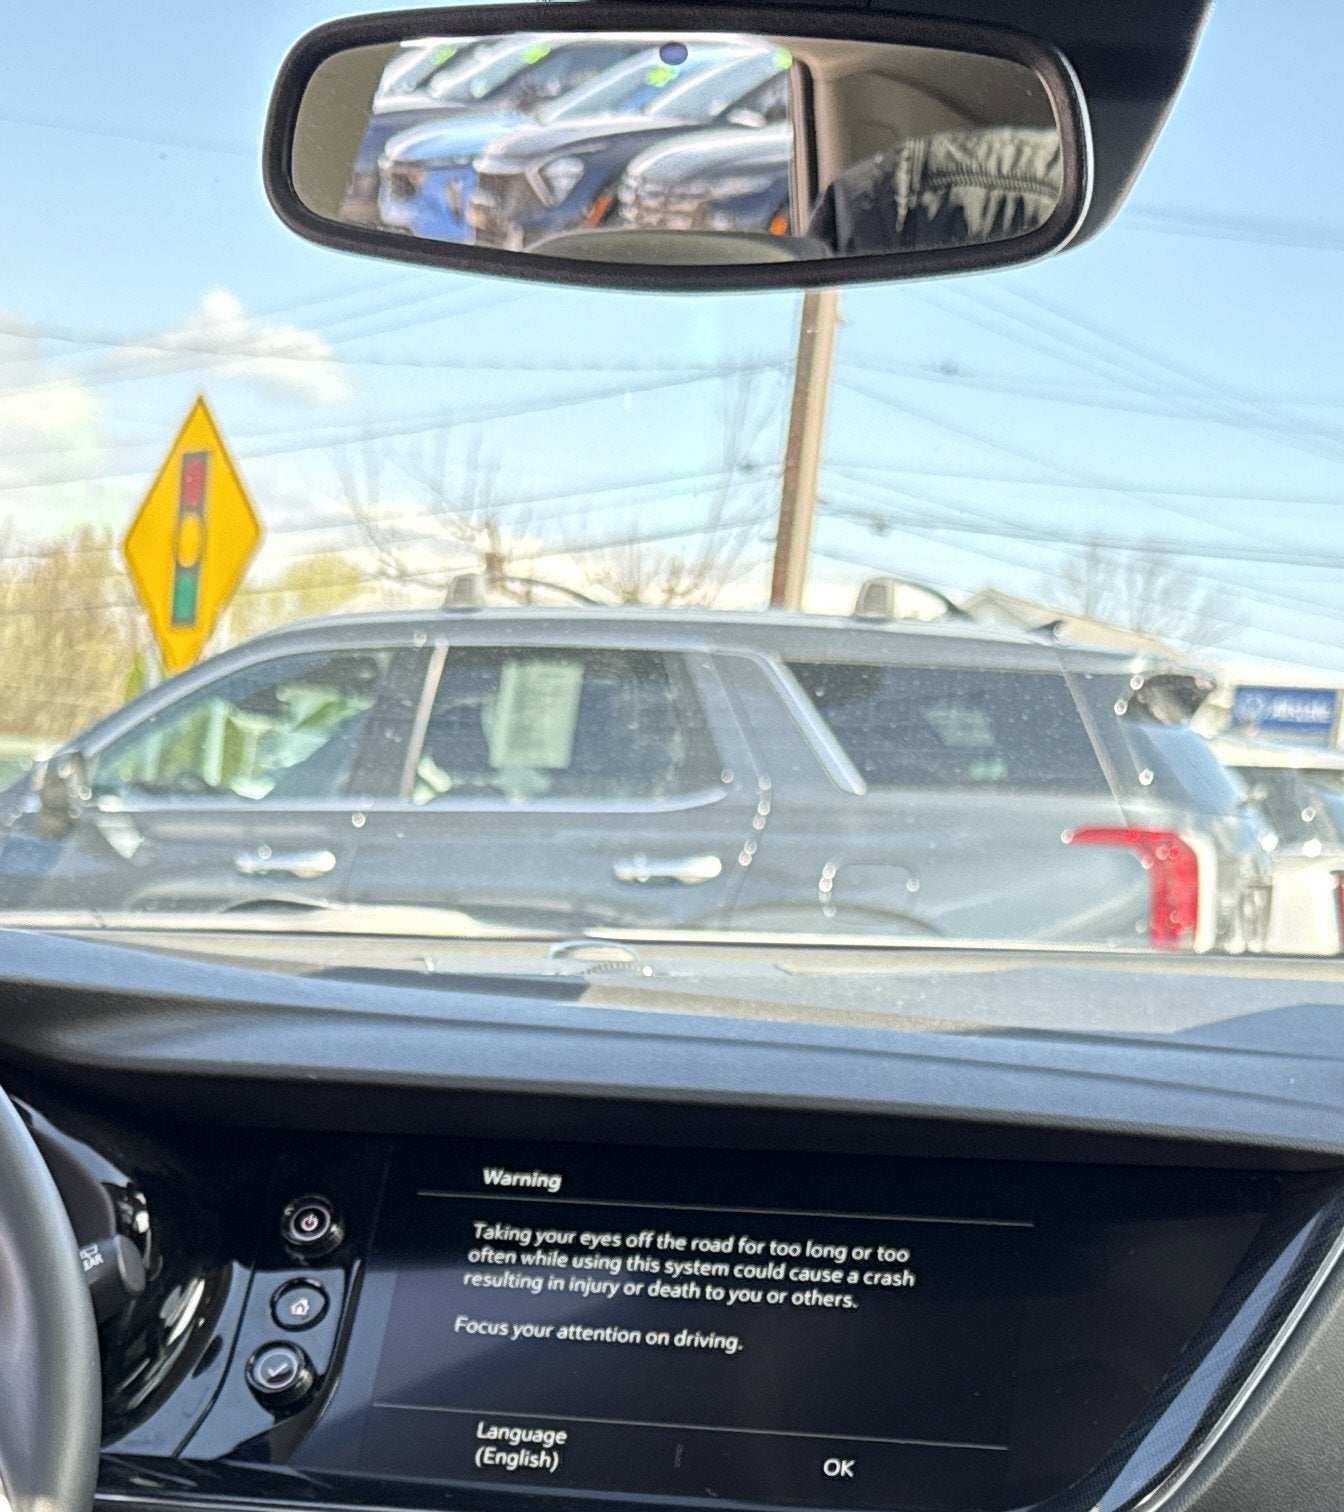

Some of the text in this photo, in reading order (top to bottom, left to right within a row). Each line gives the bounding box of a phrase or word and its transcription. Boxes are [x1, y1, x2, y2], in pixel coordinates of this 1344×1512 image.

[482, 1167, 563, 1193] Warning
[473, 1220, 910, 1263] Taking your eyes off the road for too long or too
[468, 1246, 916, 1287] often while using this system could cause a crash
[463, 1271, 859, 1308] resulting in injury or death to you or others.
[454, 1315, 744, 1354] Focus your attention on driving.
[476, 1420, 568, 1447] Language
[474, 1446, 559, 1473] (English)
[823, 1458, 856, 1478] OK
